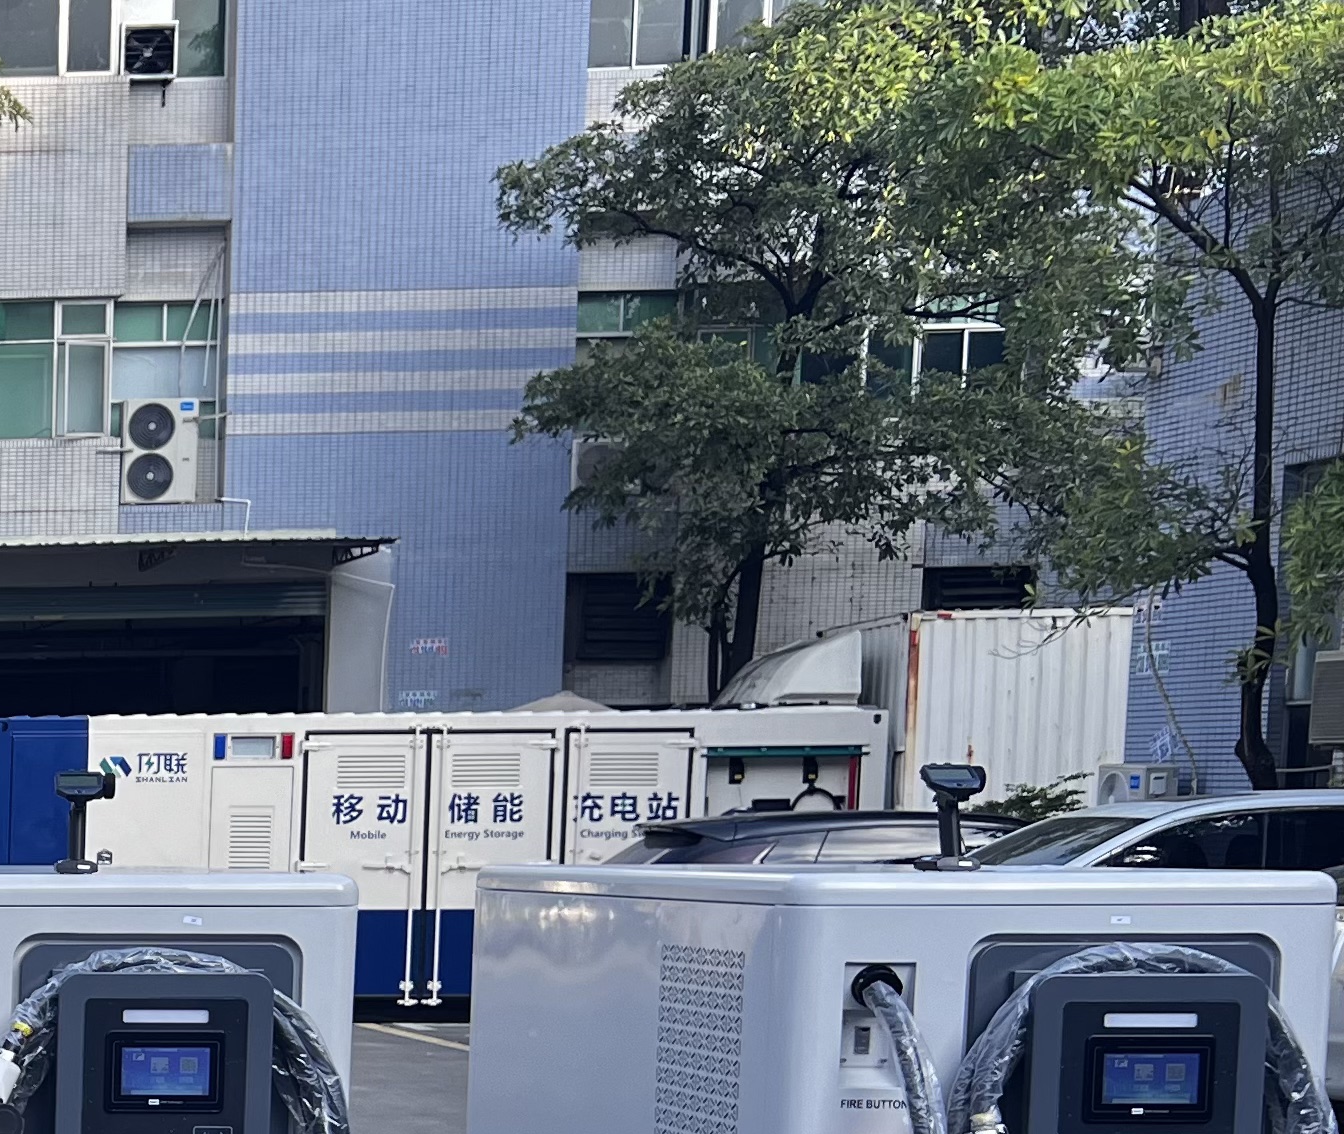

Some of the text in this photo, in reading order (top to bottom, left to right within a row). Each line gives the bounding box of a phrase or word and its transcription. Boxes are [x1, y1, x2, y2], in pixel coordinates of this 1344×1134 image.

[332, 793, 408, 825] 移动
[448, 792, 524, 825] 储能
[573, 791, 680, 822] 充电站
[350, 830, 387, 840] Mobile
[444, 829, 525, 841] Energy Storage
[579, 828, 628, 841] Charging
[840, 1099, 864, 1109] FIRE
